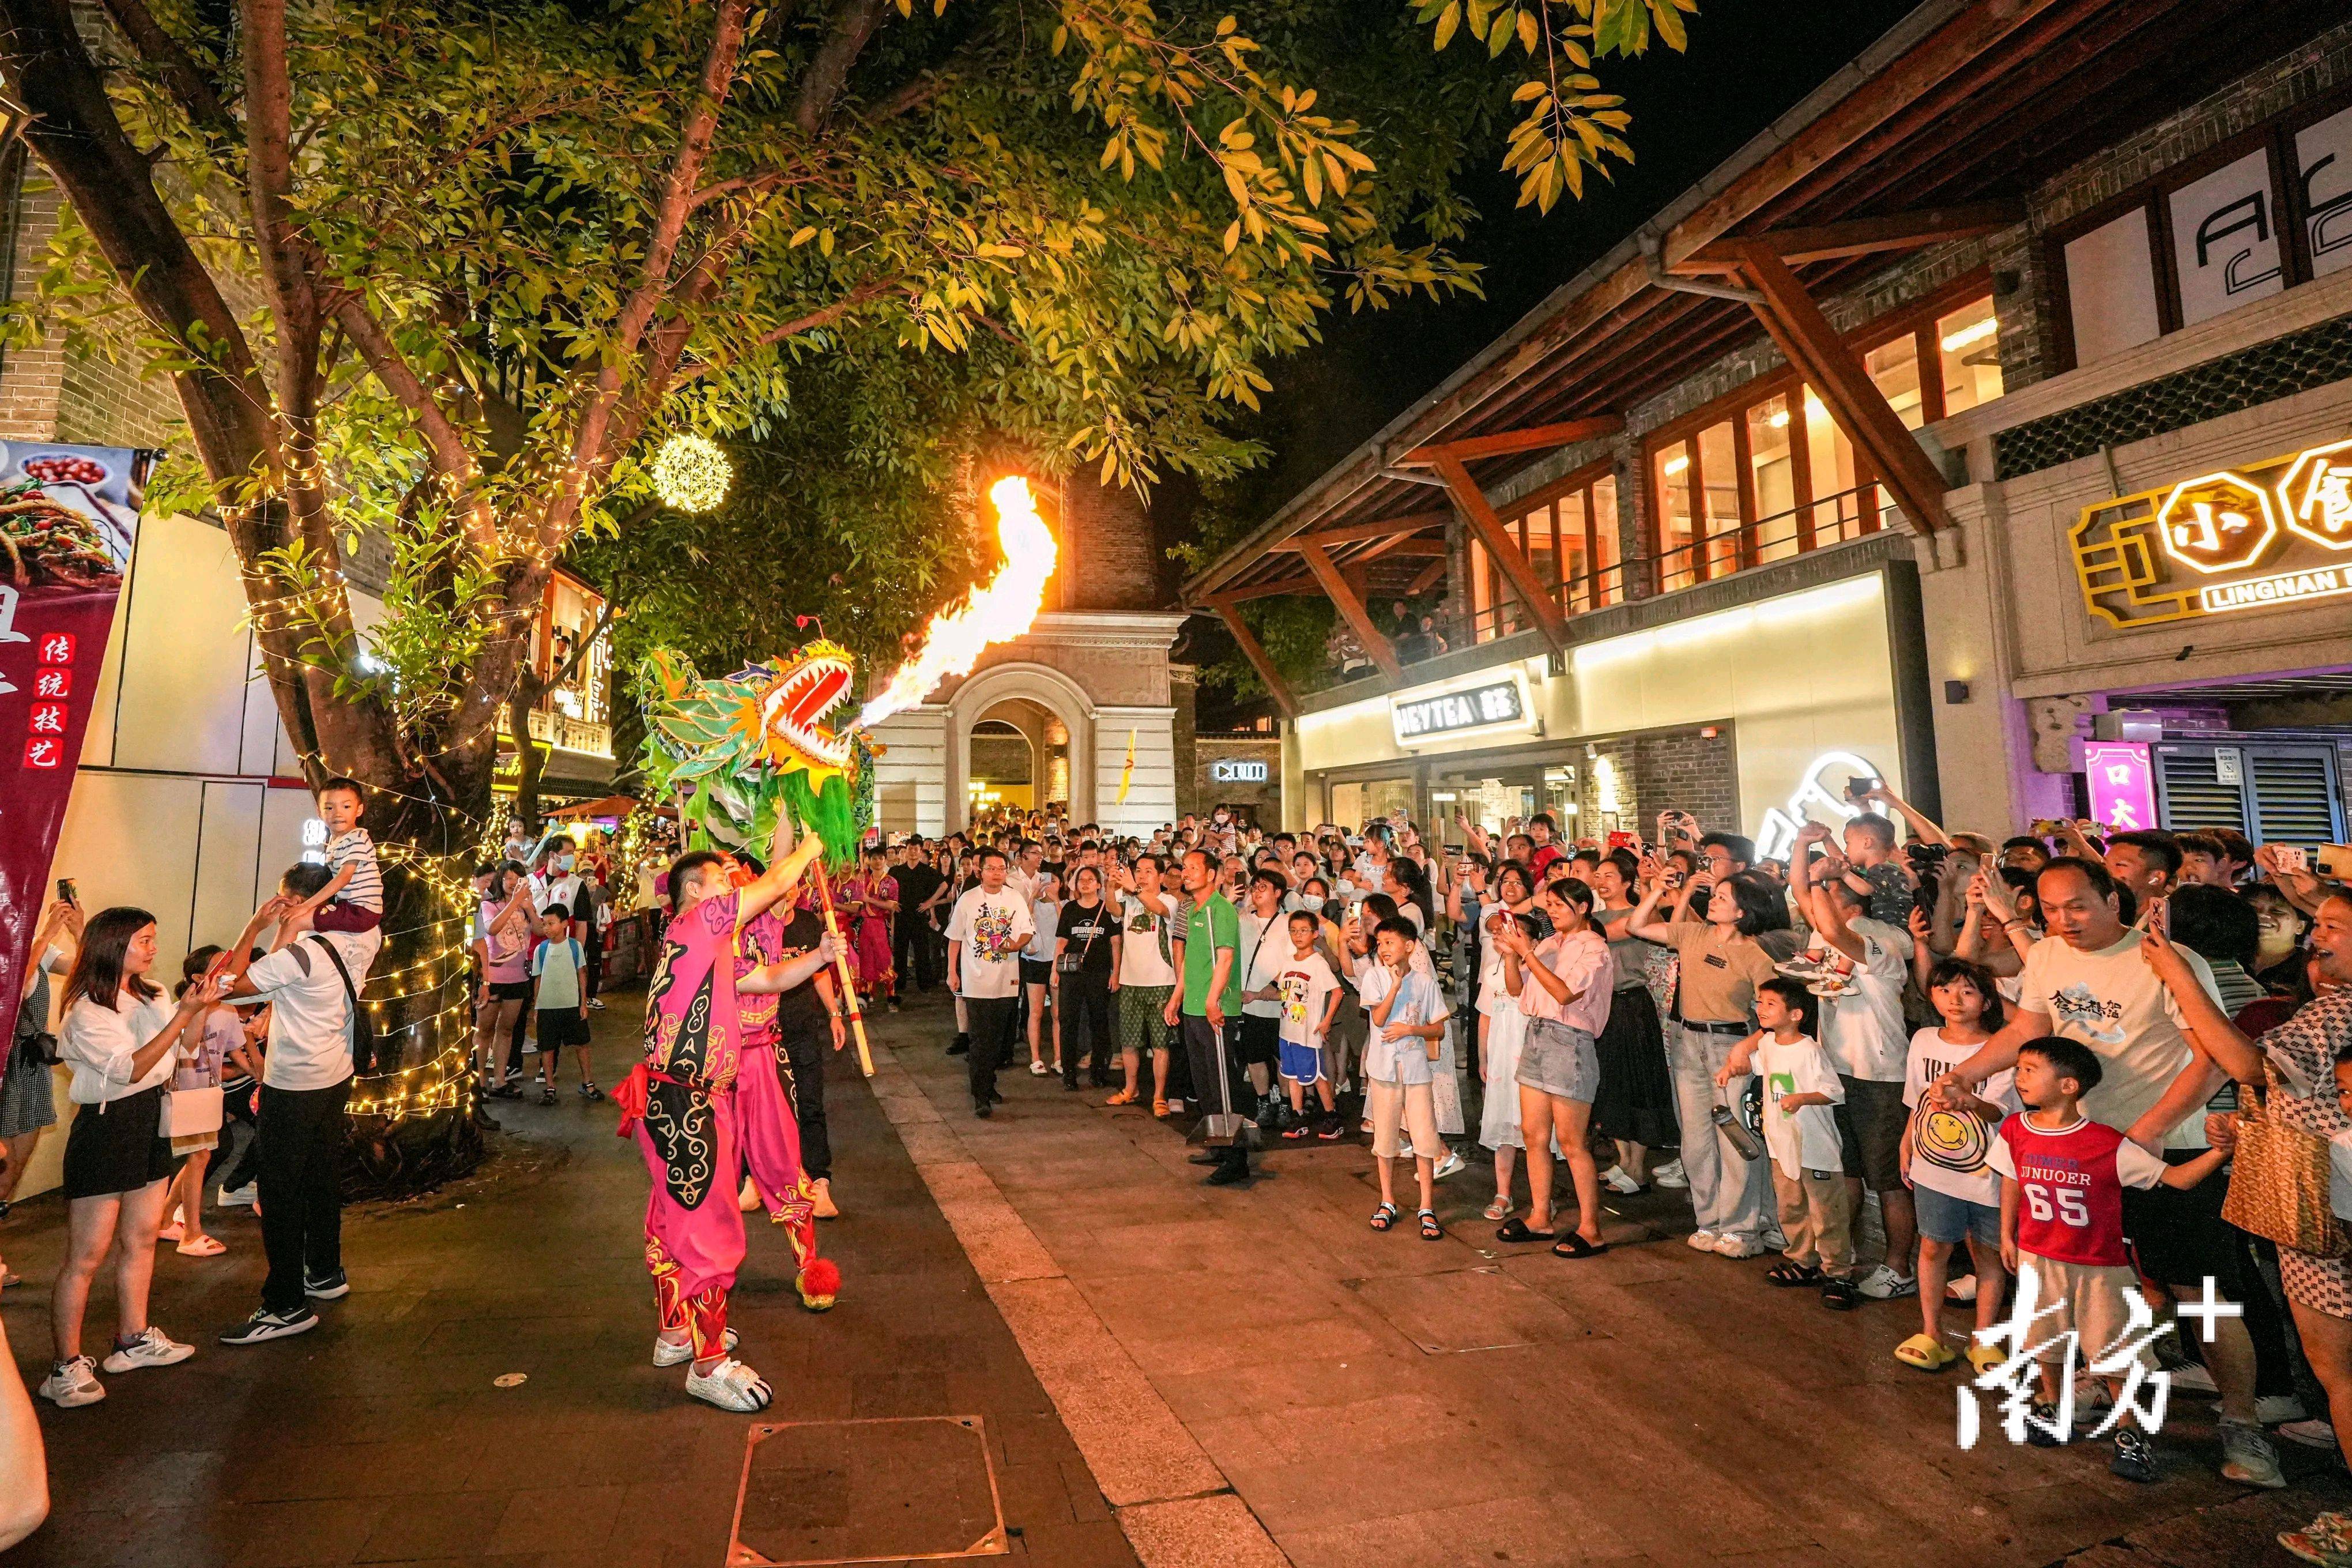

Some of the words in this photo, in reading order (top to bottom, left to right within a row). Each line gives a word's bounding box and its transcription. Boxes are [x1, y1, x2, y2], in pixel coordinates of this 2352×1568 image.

[2211, 571, 2338, 606] LINGNAN
[28, 636, 70, 767] 传统技艺
[2023, 1183, 2089, 1227] 65
